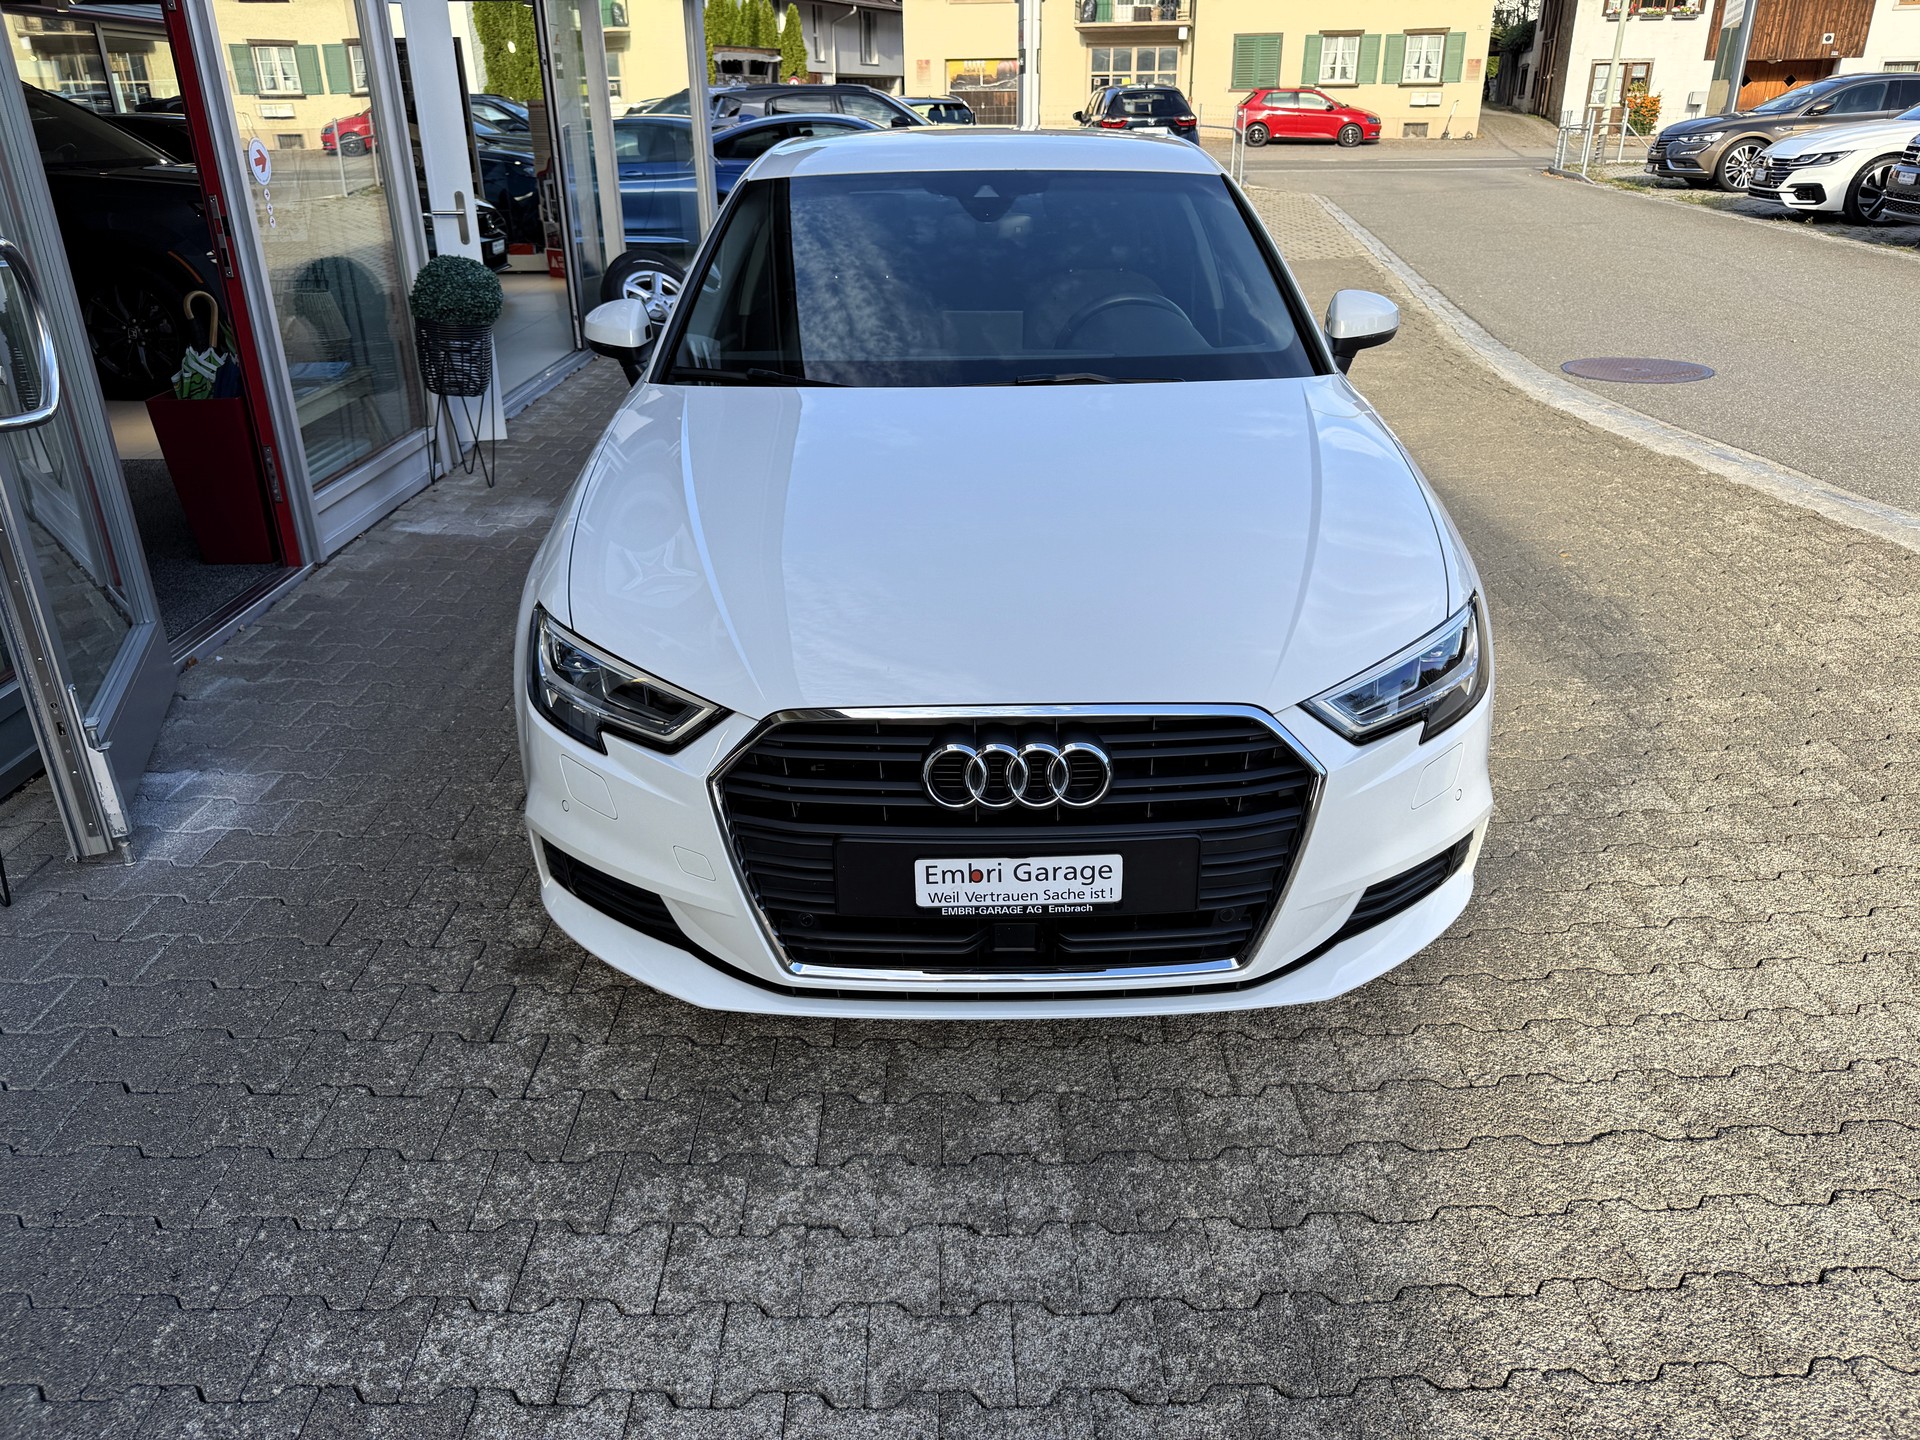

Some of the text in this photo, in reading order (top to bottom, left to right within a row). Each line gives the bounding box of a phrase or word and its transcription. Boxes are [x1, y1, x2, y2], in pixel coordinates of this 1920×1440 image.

[925, 862, 1113, 886] Embri Garage
[928, 891, 960, 904] Weil
[964, 890, 1039, 903] Vertrauen
[1043, 888, 1086, 901] Sache
[941, 903, 1093, 916] EMBRI-GARAGE AG Embrach
